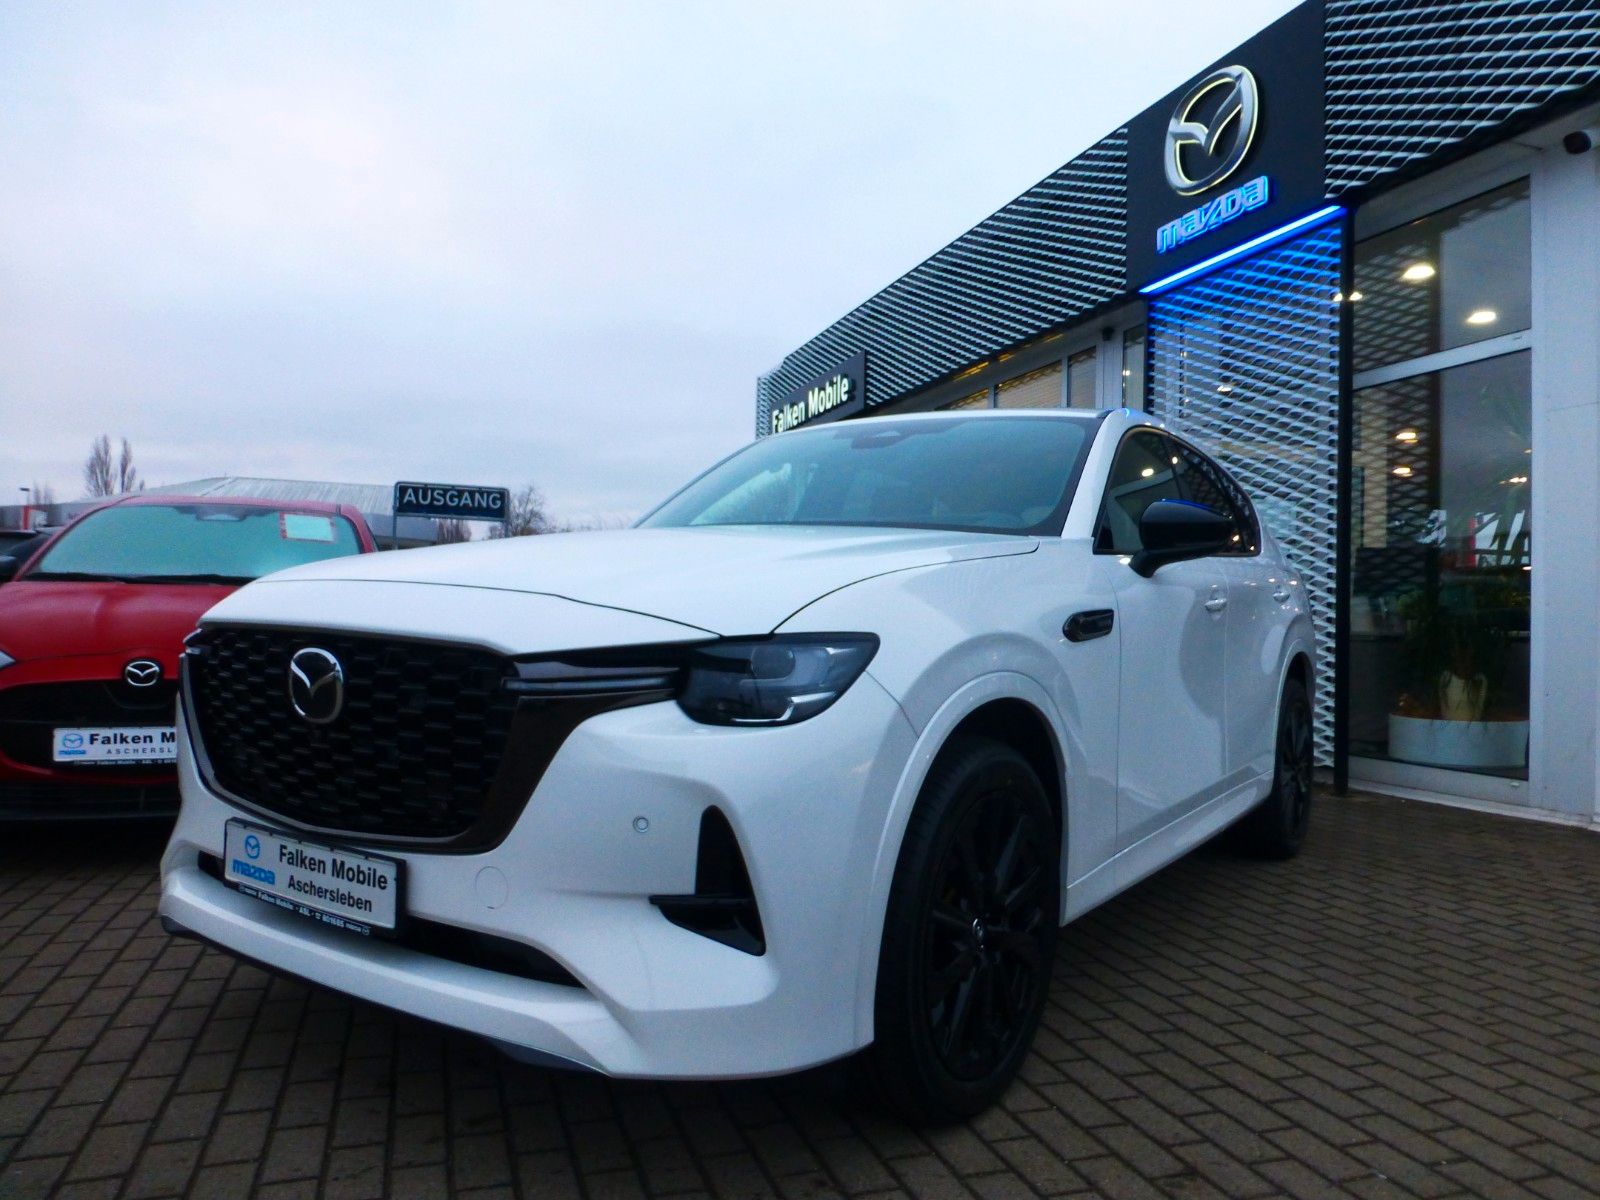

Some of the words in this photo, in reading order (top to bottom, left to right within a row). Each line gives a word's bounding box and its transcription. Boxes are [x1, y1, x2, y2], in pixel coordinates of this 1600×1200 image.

[1156, 175, 1270, 254] mazda
[772, 400, 806, 433] Falken
[808, 375, 849, 418] Mobile
[403, 487, 502, 509] AUSGANG
[89, 733, 153, 745] Falken
[160, 731, 176, 743] M
[107, 747, 174, 755] ASCHERSL
[232, 859, 275, 885] mazda
[279, 844, 326, 874] Falken
[331, 858, 388, 890] Mobile
[288, 875, 372, 912] Aschersleben
